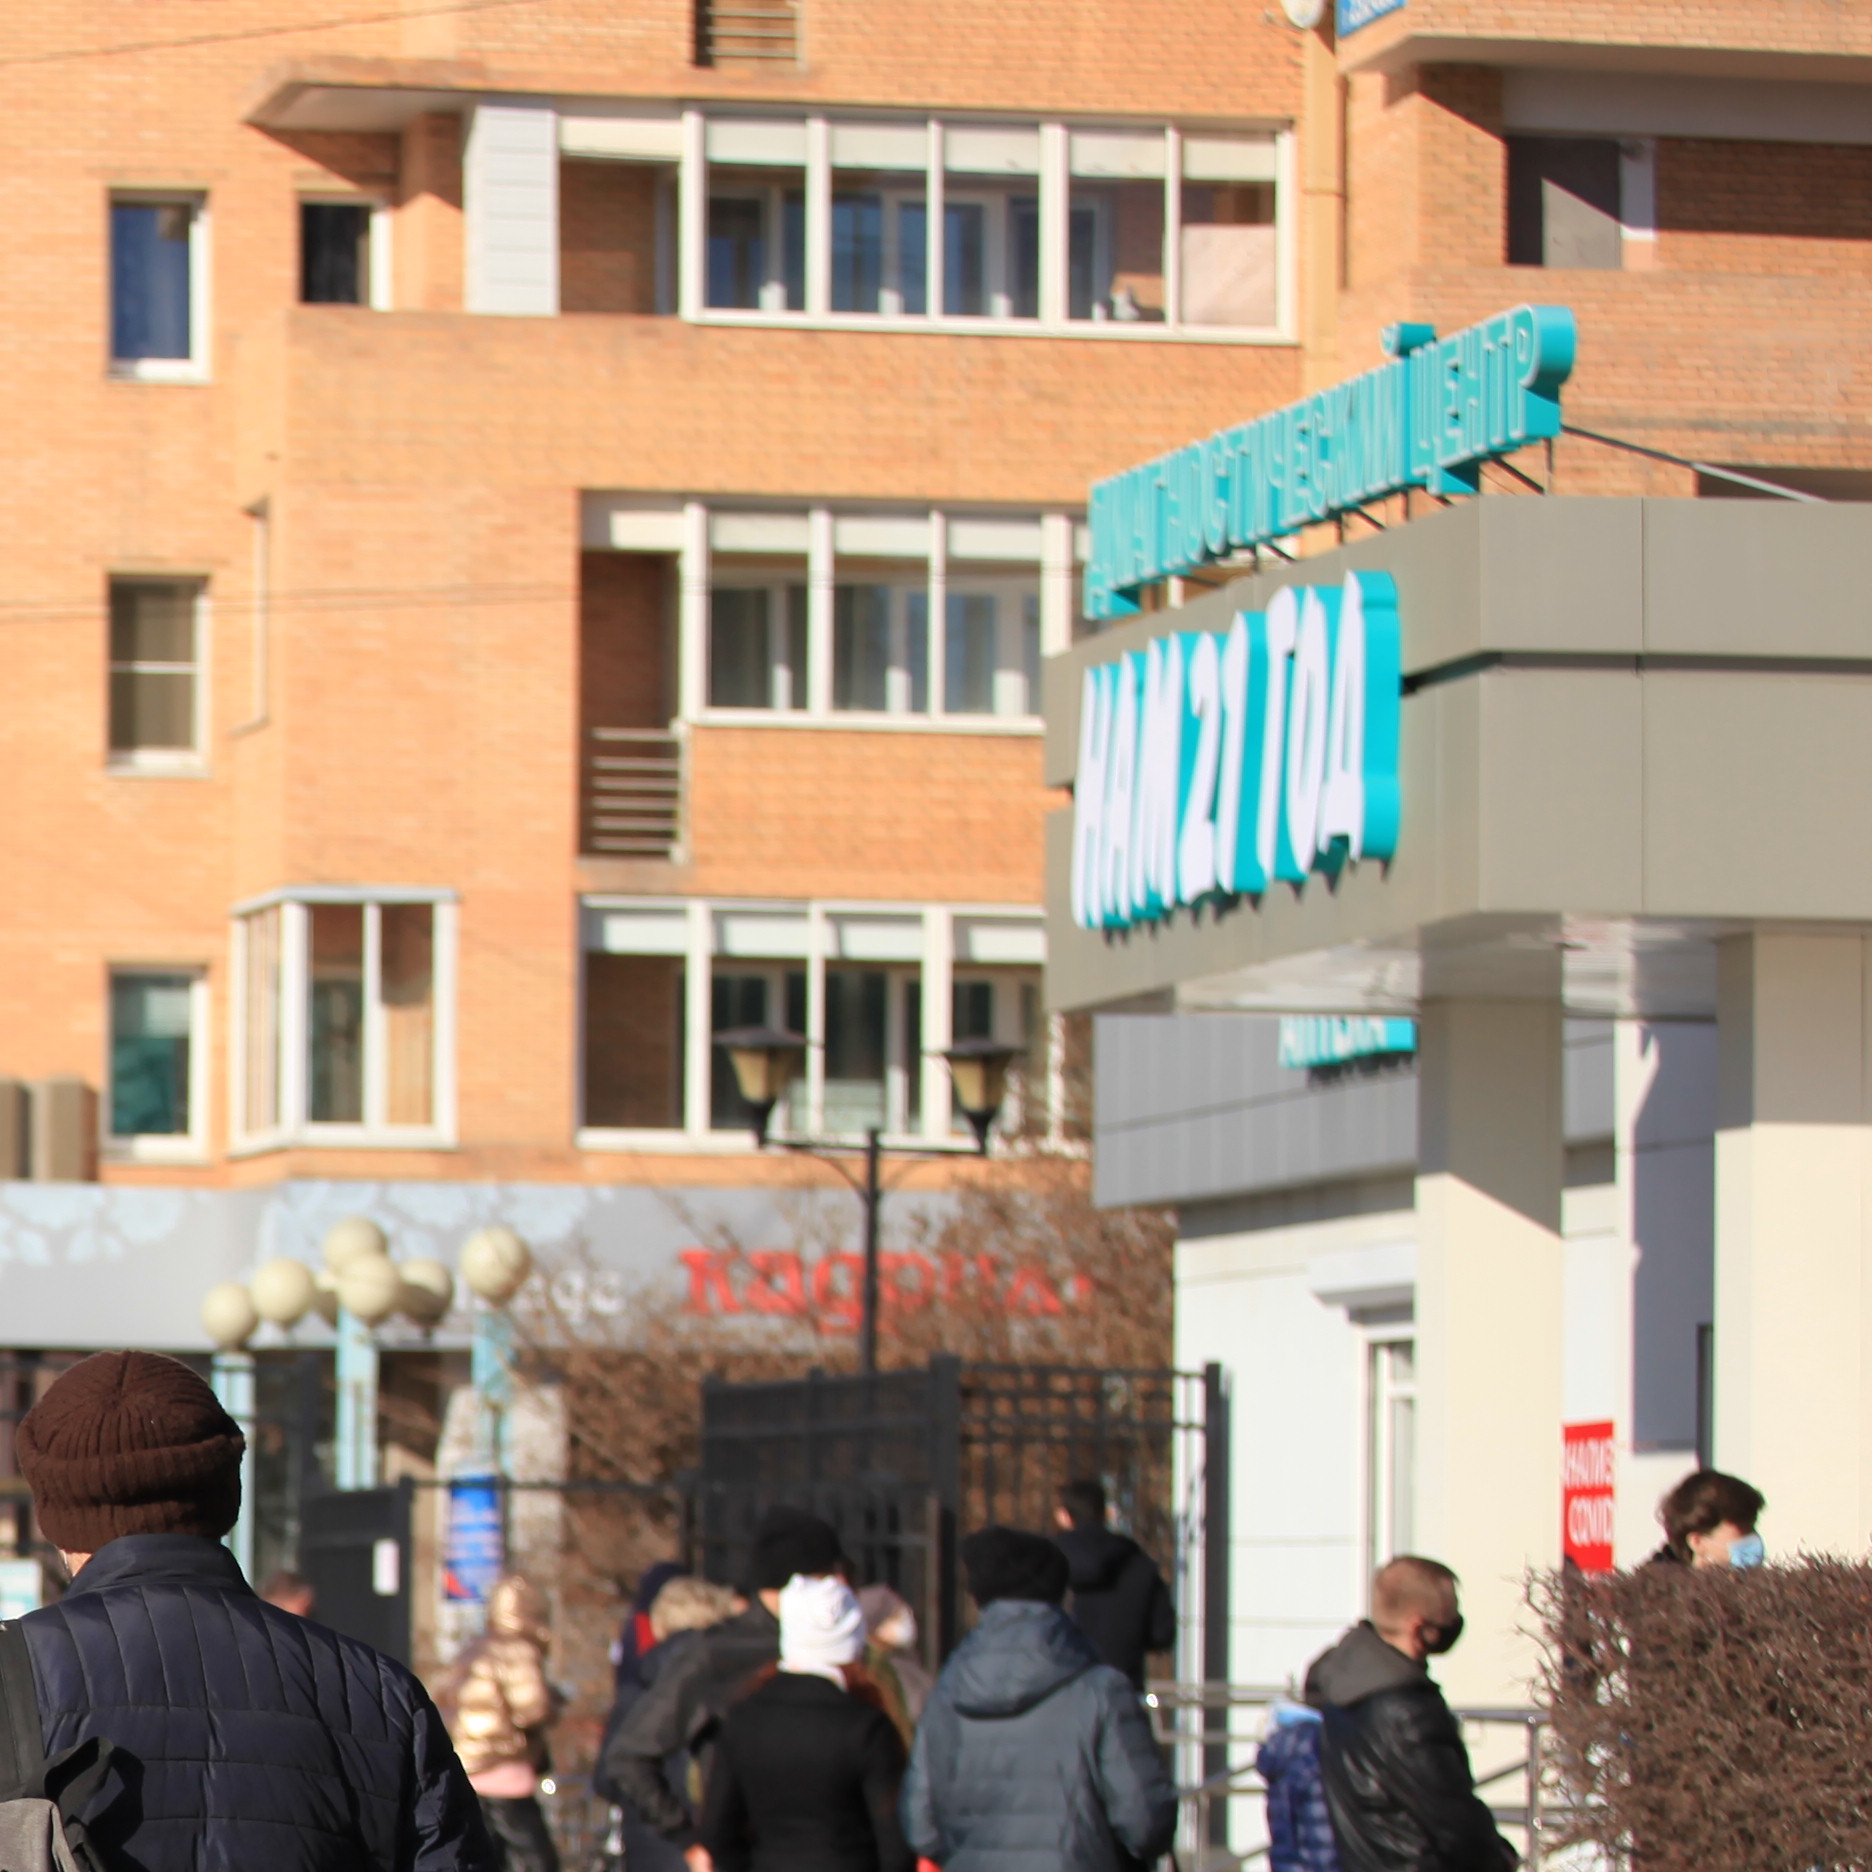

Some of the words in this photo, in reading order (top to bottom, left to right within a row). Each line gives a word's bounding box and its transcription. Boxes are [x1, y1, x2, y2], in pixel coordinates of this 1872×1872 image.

[1084, 323, 1406, 619] ДИАГНОСТИЧЕСКИЙ
[1410, 304, 1554, 494] ЦЕНТР
[1071, 631, 1185, 929] НАМ
[1178, 610, 1251, 904] 21
[1257, 571, 1366, 882] ГОД
